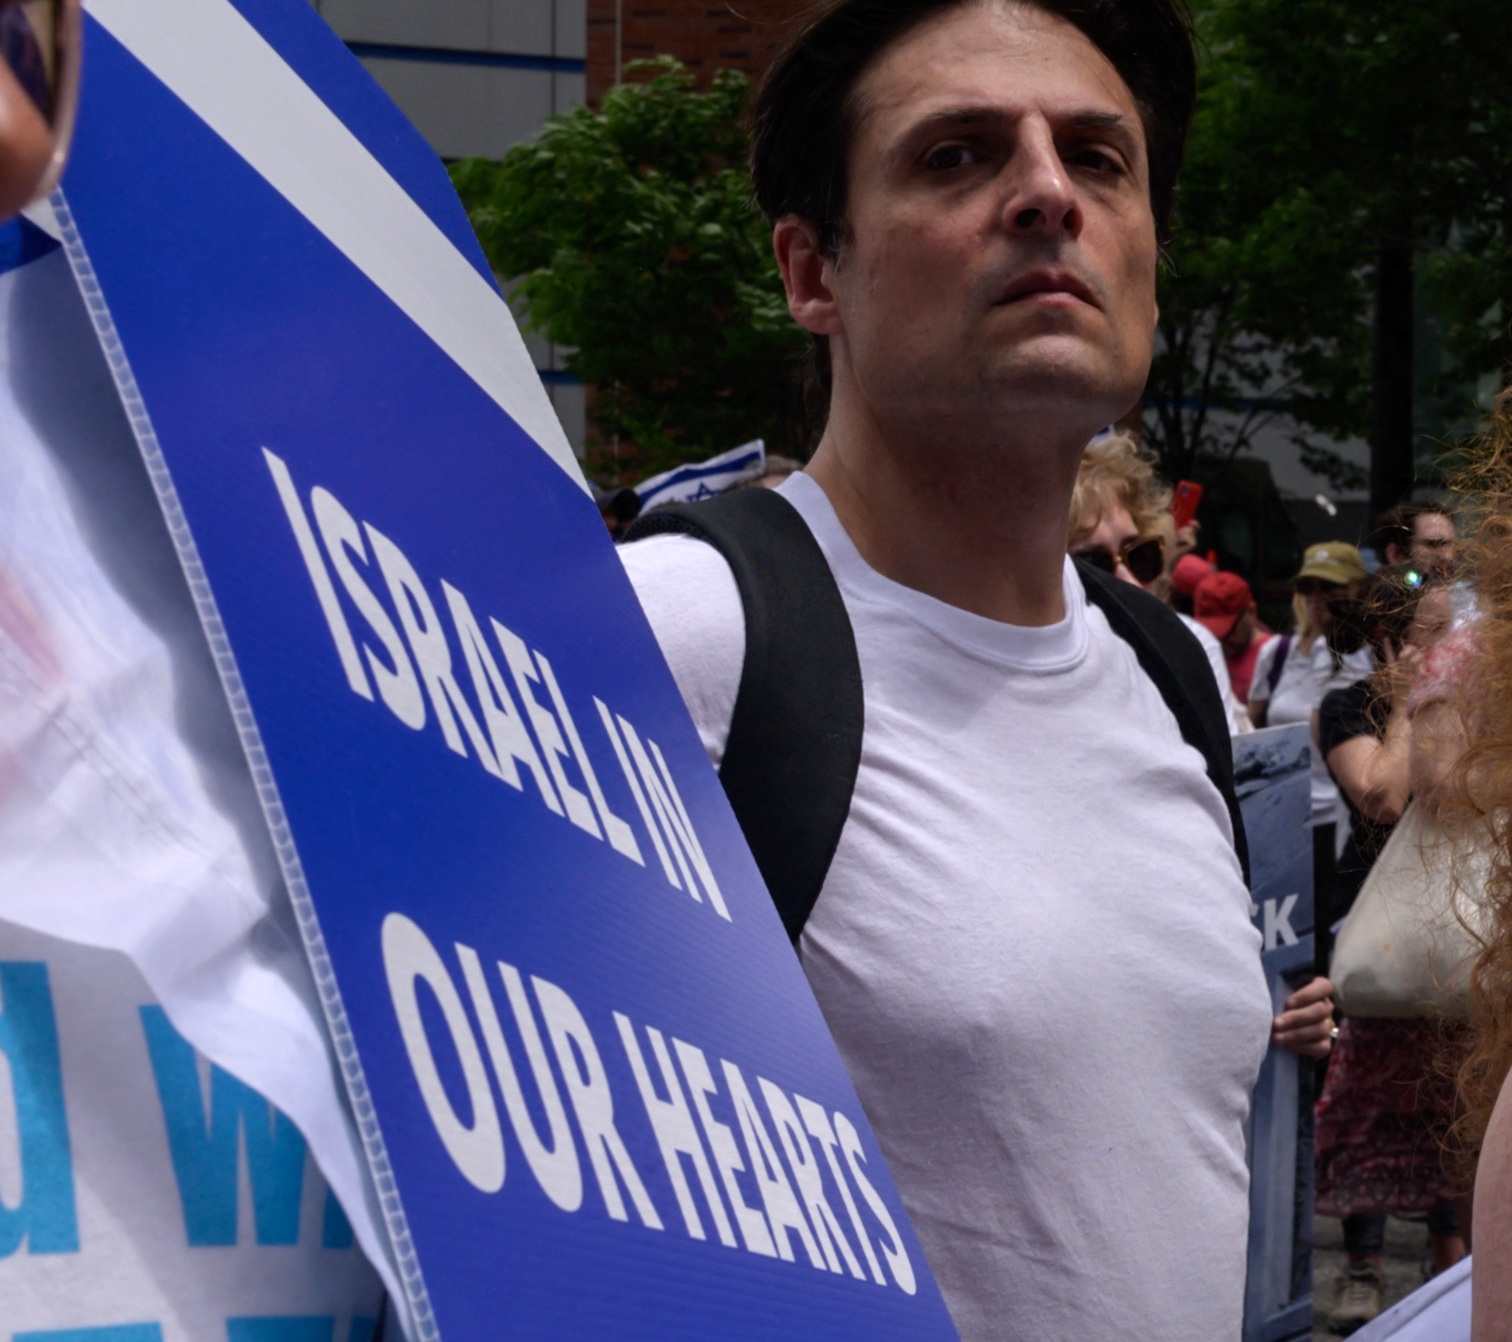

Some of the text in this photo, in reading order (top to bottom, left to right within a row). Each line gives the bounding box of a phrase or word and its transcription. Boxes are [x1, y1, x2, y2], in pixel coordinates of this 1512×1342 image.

[260, 445, 732, 921] ISRAEL IN
[379, 911, 918, 1297] OUR HEARTS
